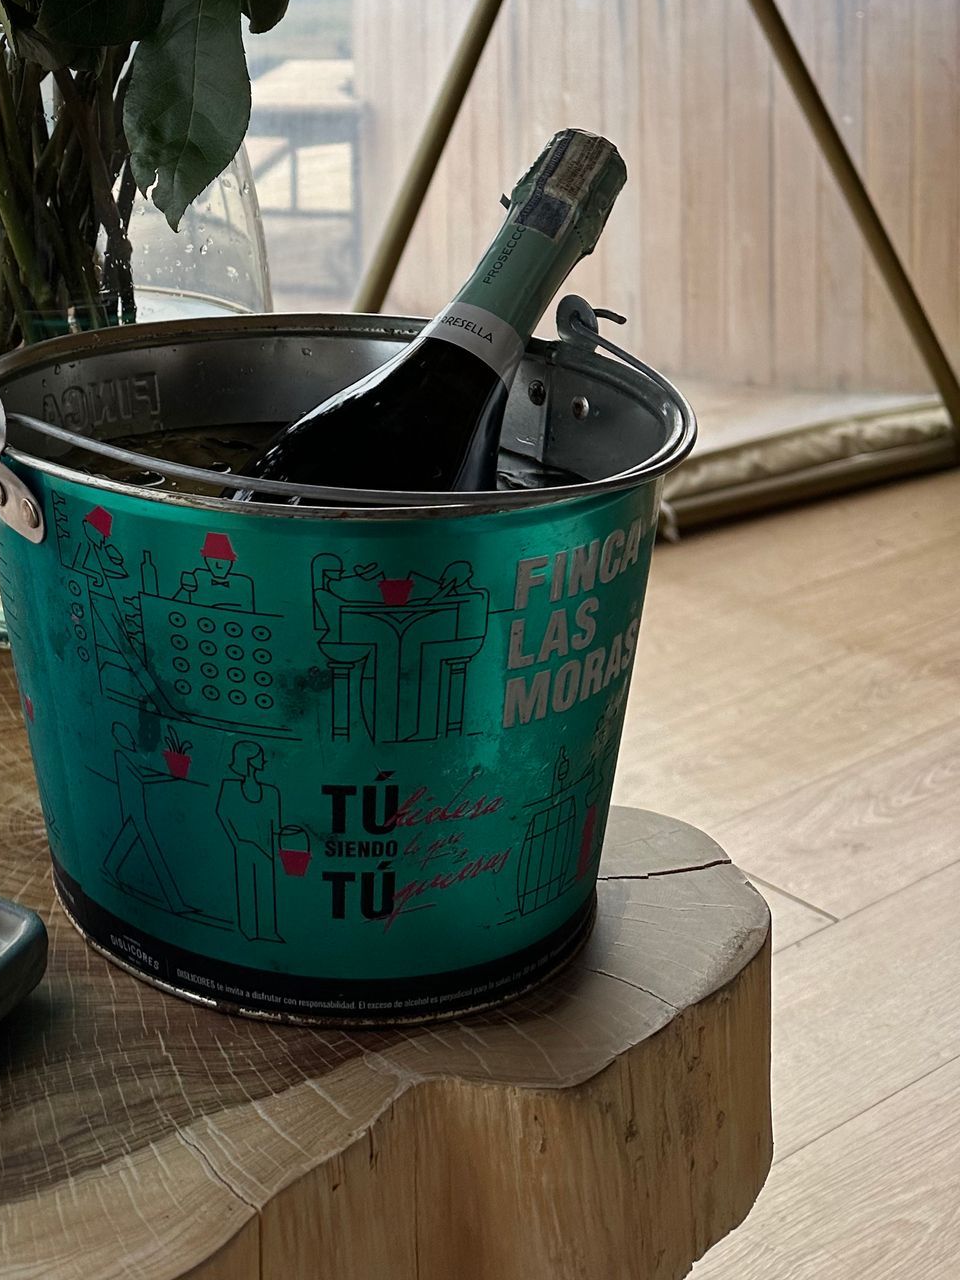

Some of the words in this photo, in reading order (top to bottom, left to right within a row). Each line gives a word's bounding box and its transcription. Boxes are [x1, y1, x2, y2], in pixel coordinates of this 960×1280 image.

[514, 518, 642, 610] FINCA
[507, 596, 599, 670] LAS
[503, 618, 641, 729] MORAS
[321, 770, 399, 836] TÚ
[324, 840, 398, 858] SIENDO
[321, 860, 396, 920] TÚ
[109, 933, 160, 971] DISLICORES
[252, 990, 282, 1003] disfrutar
[283, 996, 297, 1006] con
[367, 1001, 392, 1010] exceso
[404, 996, 430, 1008] alcohol
